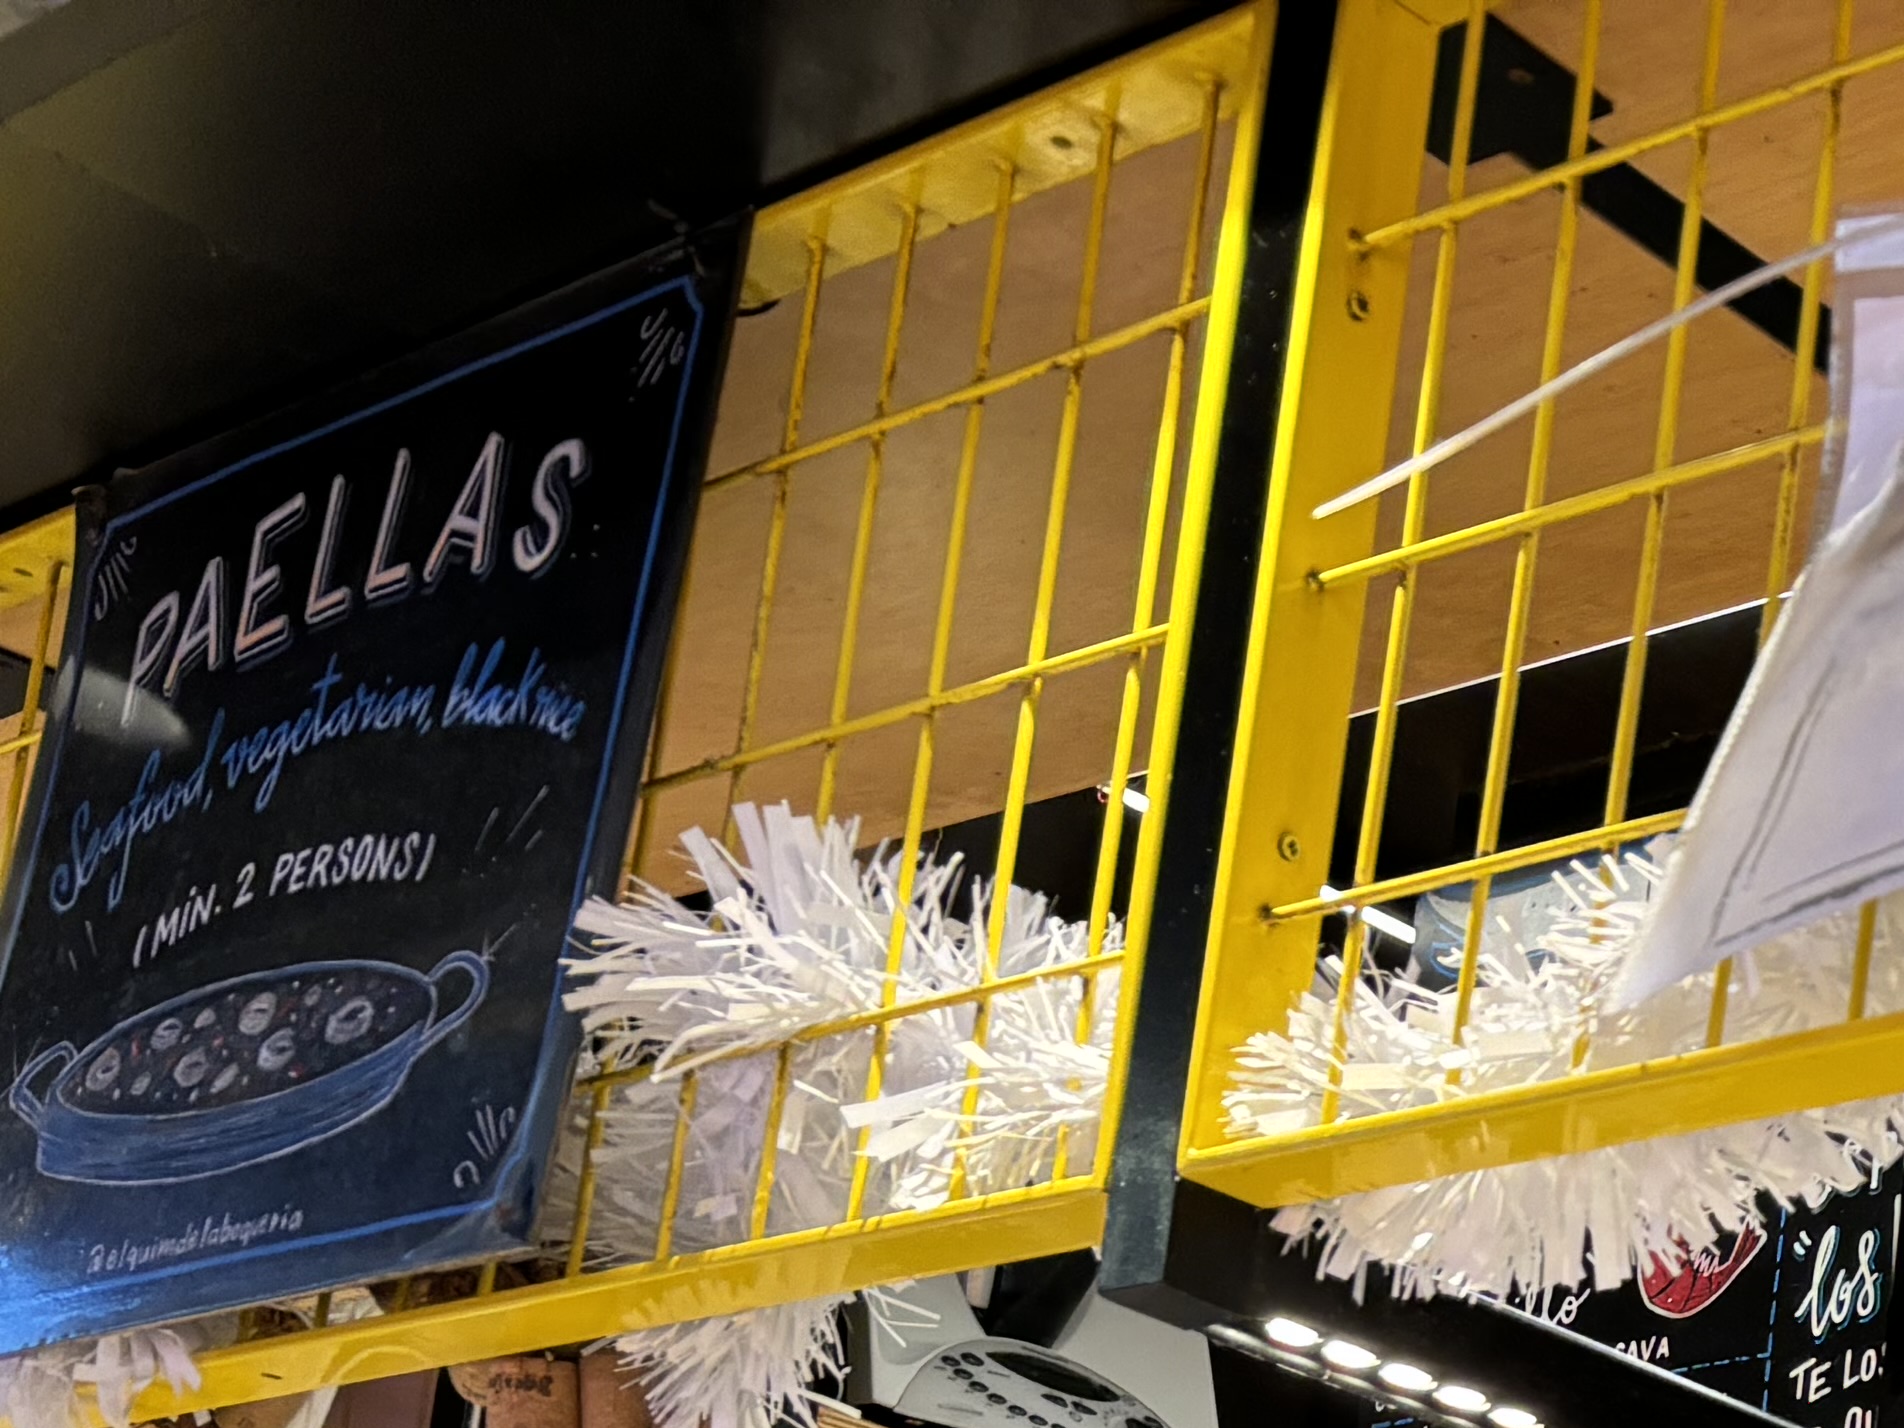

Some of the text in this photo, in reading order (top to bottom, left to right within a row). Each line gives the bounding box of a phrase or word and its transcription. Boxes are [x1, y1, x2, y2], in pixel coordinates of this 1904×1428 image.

[121, 430, 590, 728] PAELLAS
[50, 706, 226, 914] Seafood,
[441, 636, 548, 729] black
[234, 862, 257, 908] 2
[269, 831, 437, 896] PERSONS)
[1788, 1355, 1833, 1403] TE
